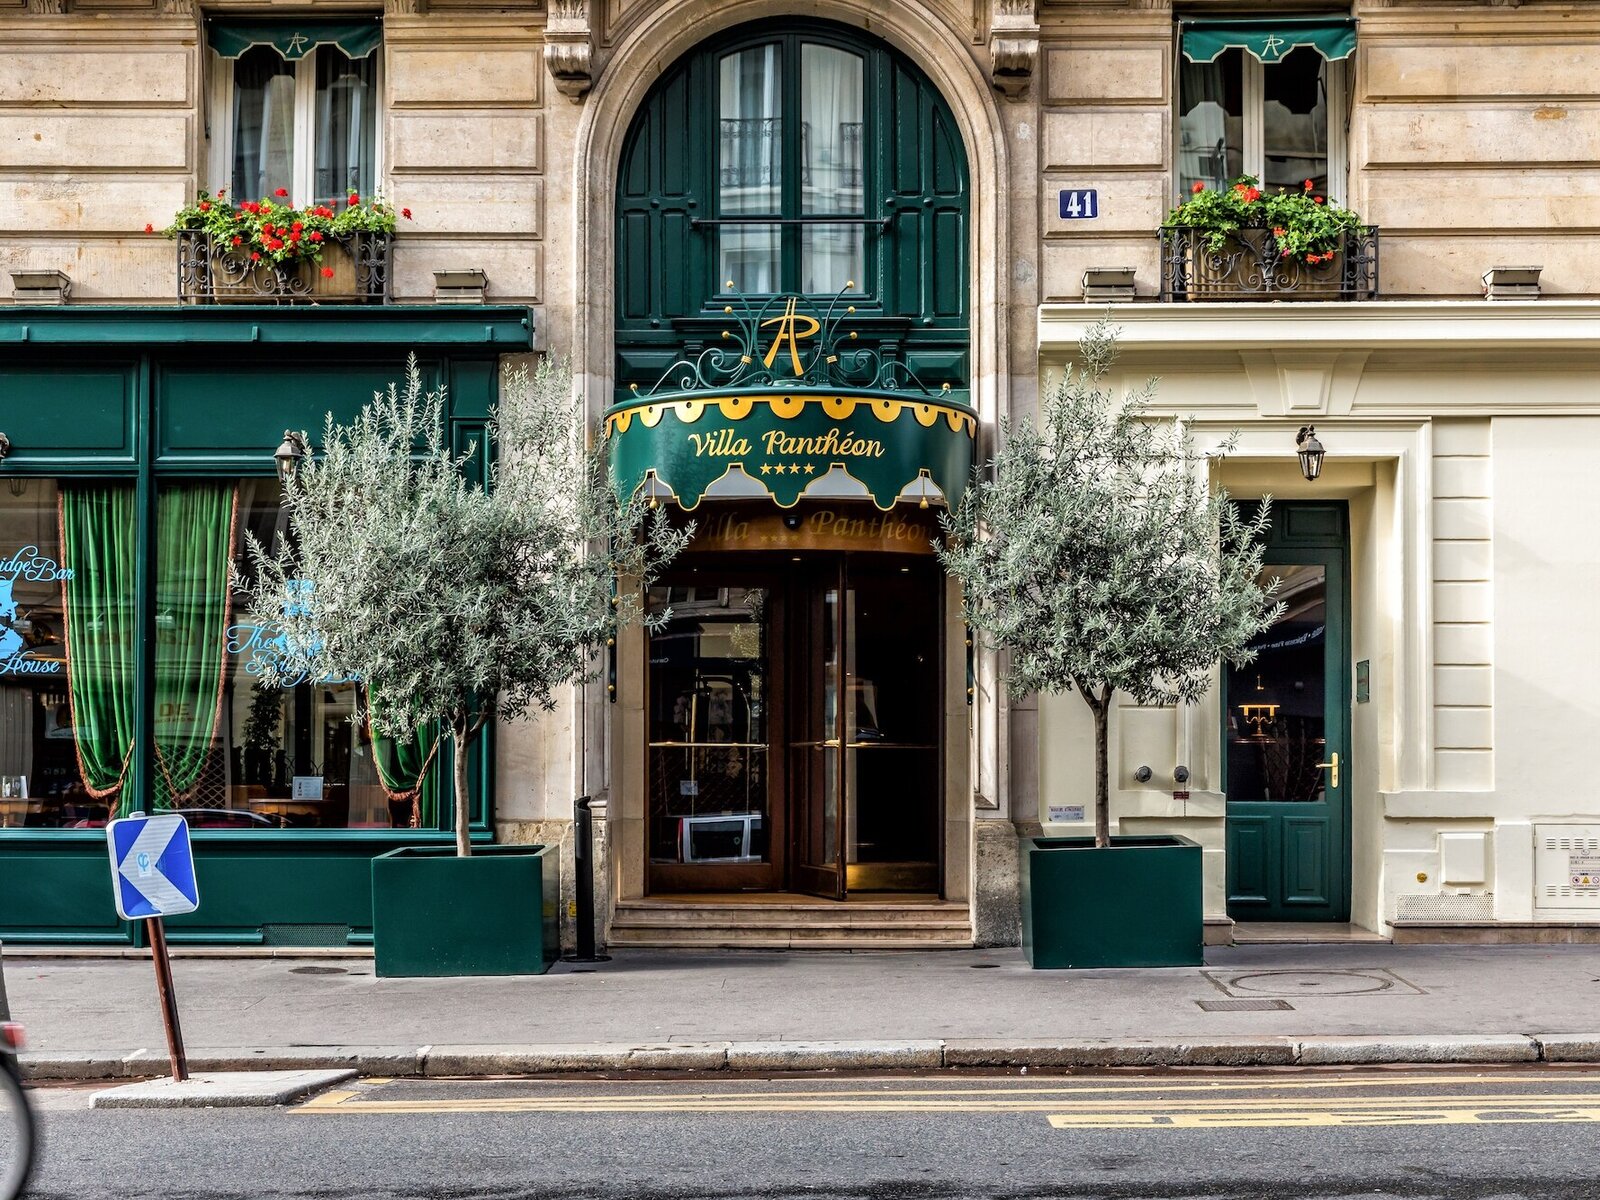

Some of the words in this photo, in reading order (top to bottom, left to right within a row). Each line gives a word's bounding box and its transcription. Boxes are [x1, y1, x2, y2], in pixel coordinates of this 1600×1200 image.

[1066, 191, 1093, 217] 41
[688, 429, 752, 457] Villa
[761, 427, 886, 458] Panthéon
[810, 510, 934, 541] Panthéon
[226, 622, 277, 654] The
[0, 650, 61, 676] House
